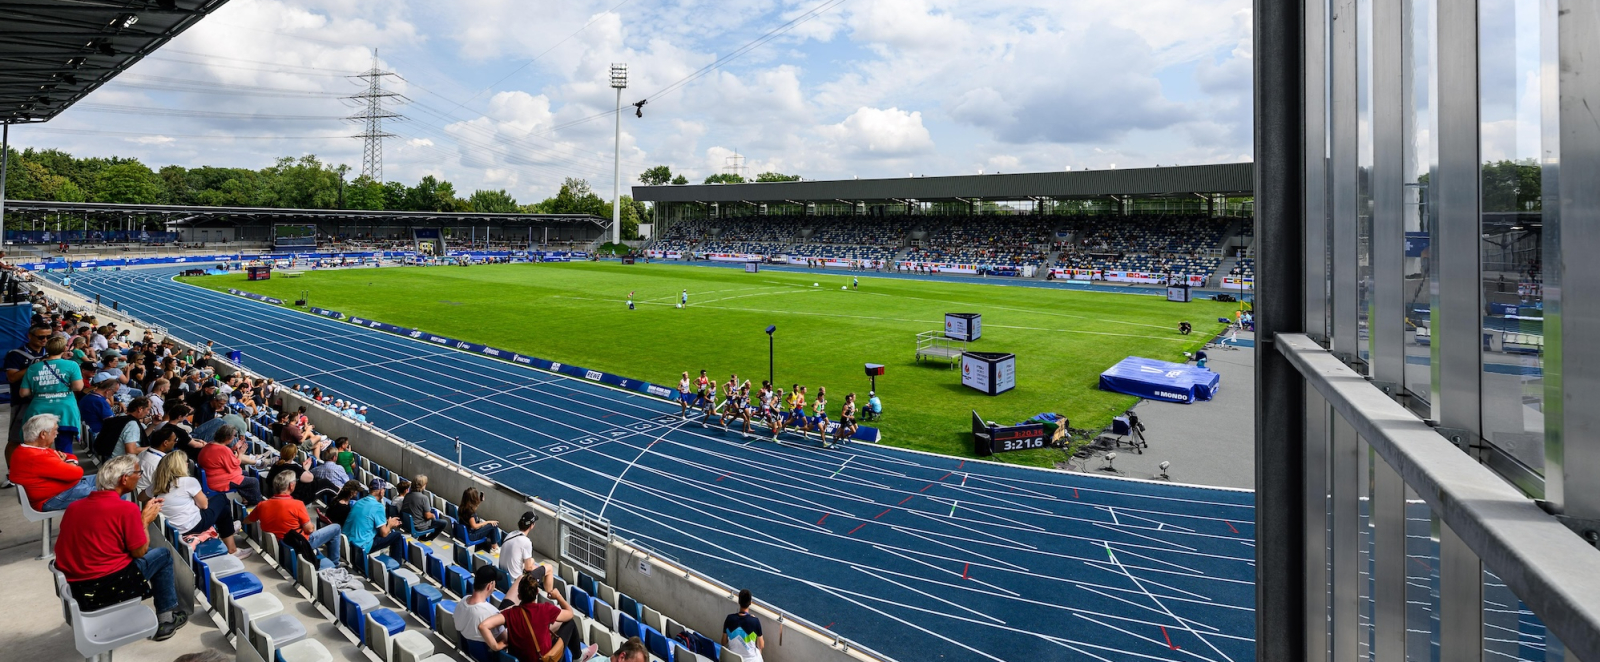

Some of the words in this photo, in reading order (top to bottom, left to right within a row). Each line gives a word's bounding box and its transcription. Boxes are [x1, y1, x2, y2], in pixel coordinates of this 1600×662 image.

[1160, 391, 1188, 400] MONDO
[1004, 438, 1043, 450] 3:21.6
[479, 463, 502, 471] 8
